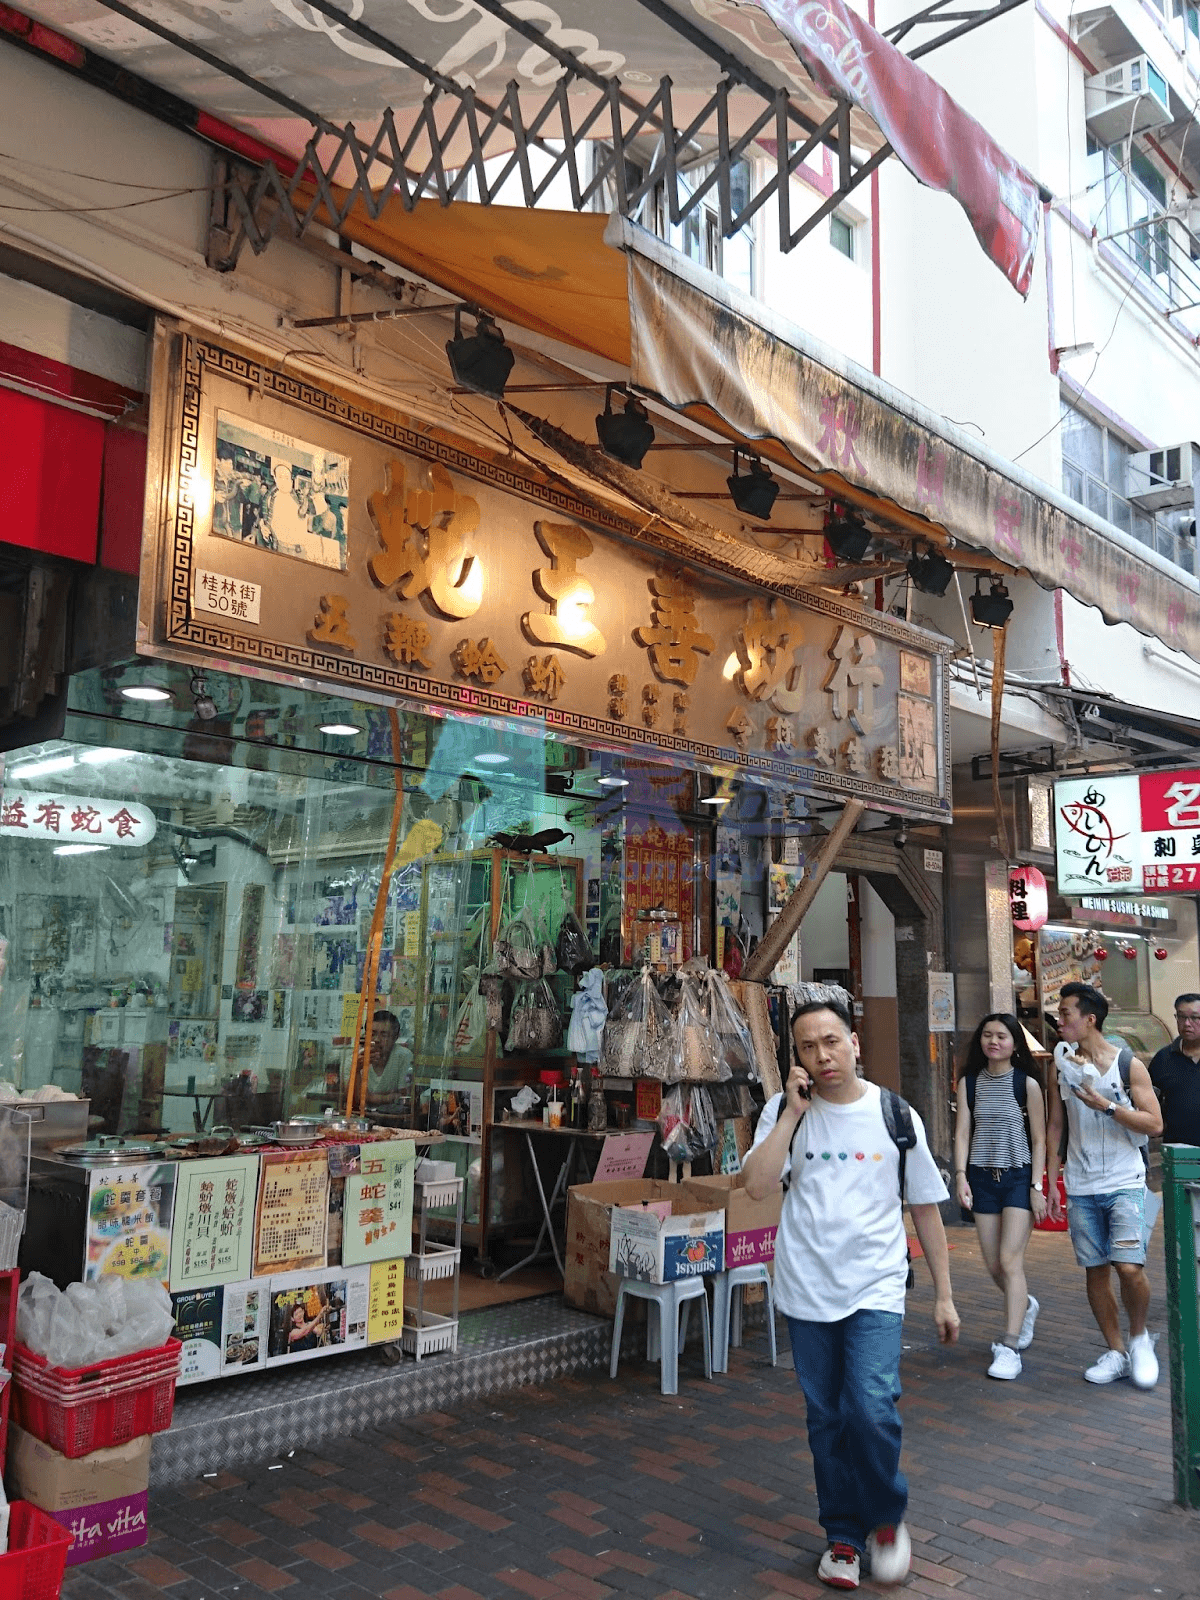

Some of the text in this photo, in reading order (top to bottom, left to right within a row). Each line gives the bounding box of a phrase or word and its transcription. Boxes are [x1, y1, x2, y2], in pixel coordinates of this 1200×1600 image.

[201, 574, 256, 602] 桂林街
[207, 592, 249, 619] 50號
[1163, 781, 1200, 828] 名
[1111, 899, 1133, 915] SUSHI
[731, 1235, 755, 1257] vita
[675, 1258, 717, 1276] Sunkist
[107, 1505, 146, 1533] vita
